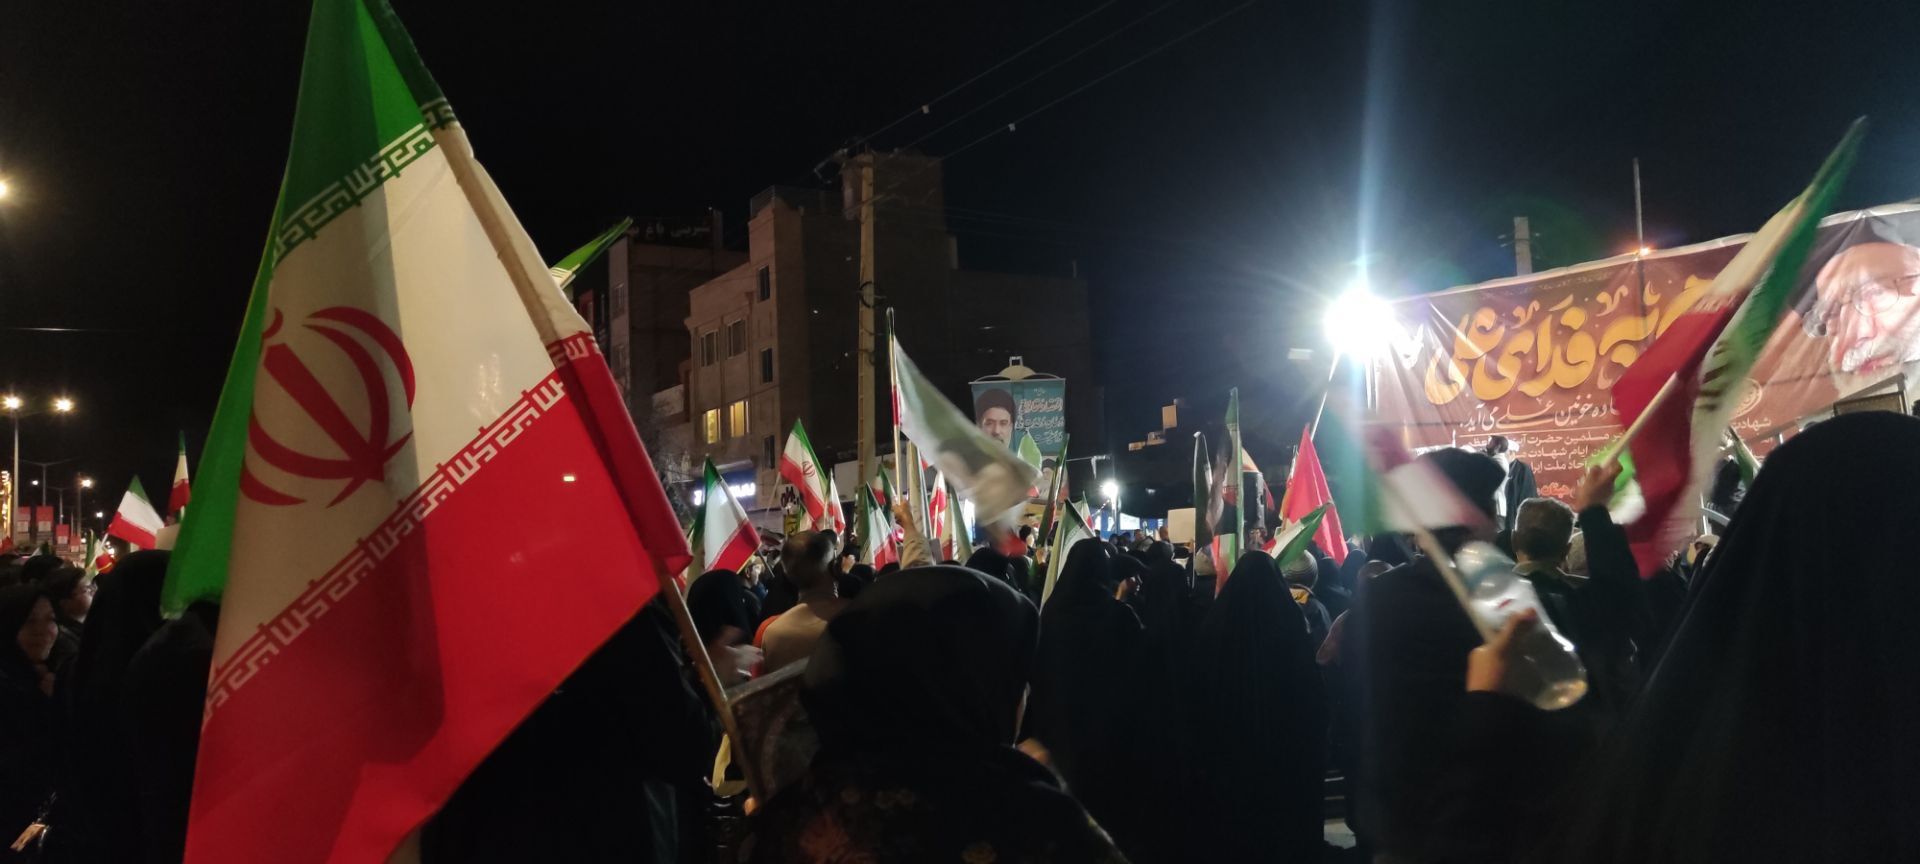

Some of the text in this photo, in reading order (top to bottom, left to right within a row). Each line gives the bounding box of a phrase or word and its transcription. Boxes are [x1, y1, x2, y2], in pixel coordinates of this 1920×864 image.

[1424, 306, 1505, 405] علی
[1471, 303, 1596, 402] فدای
[1554, 394, 1594, 427] خونین
[1592, 396, 1621, 418] اده
[1526, 433, 1563, 446] حضرت
[1564, 431, 1610, 445] مسلمین
[1527, 446, 1568, 459] شهادت
[1568, 444, 1589, 459] ایام
[1530, 461, 1543, 473] ایرا
[1543, 458, 1566, 470] ملت
